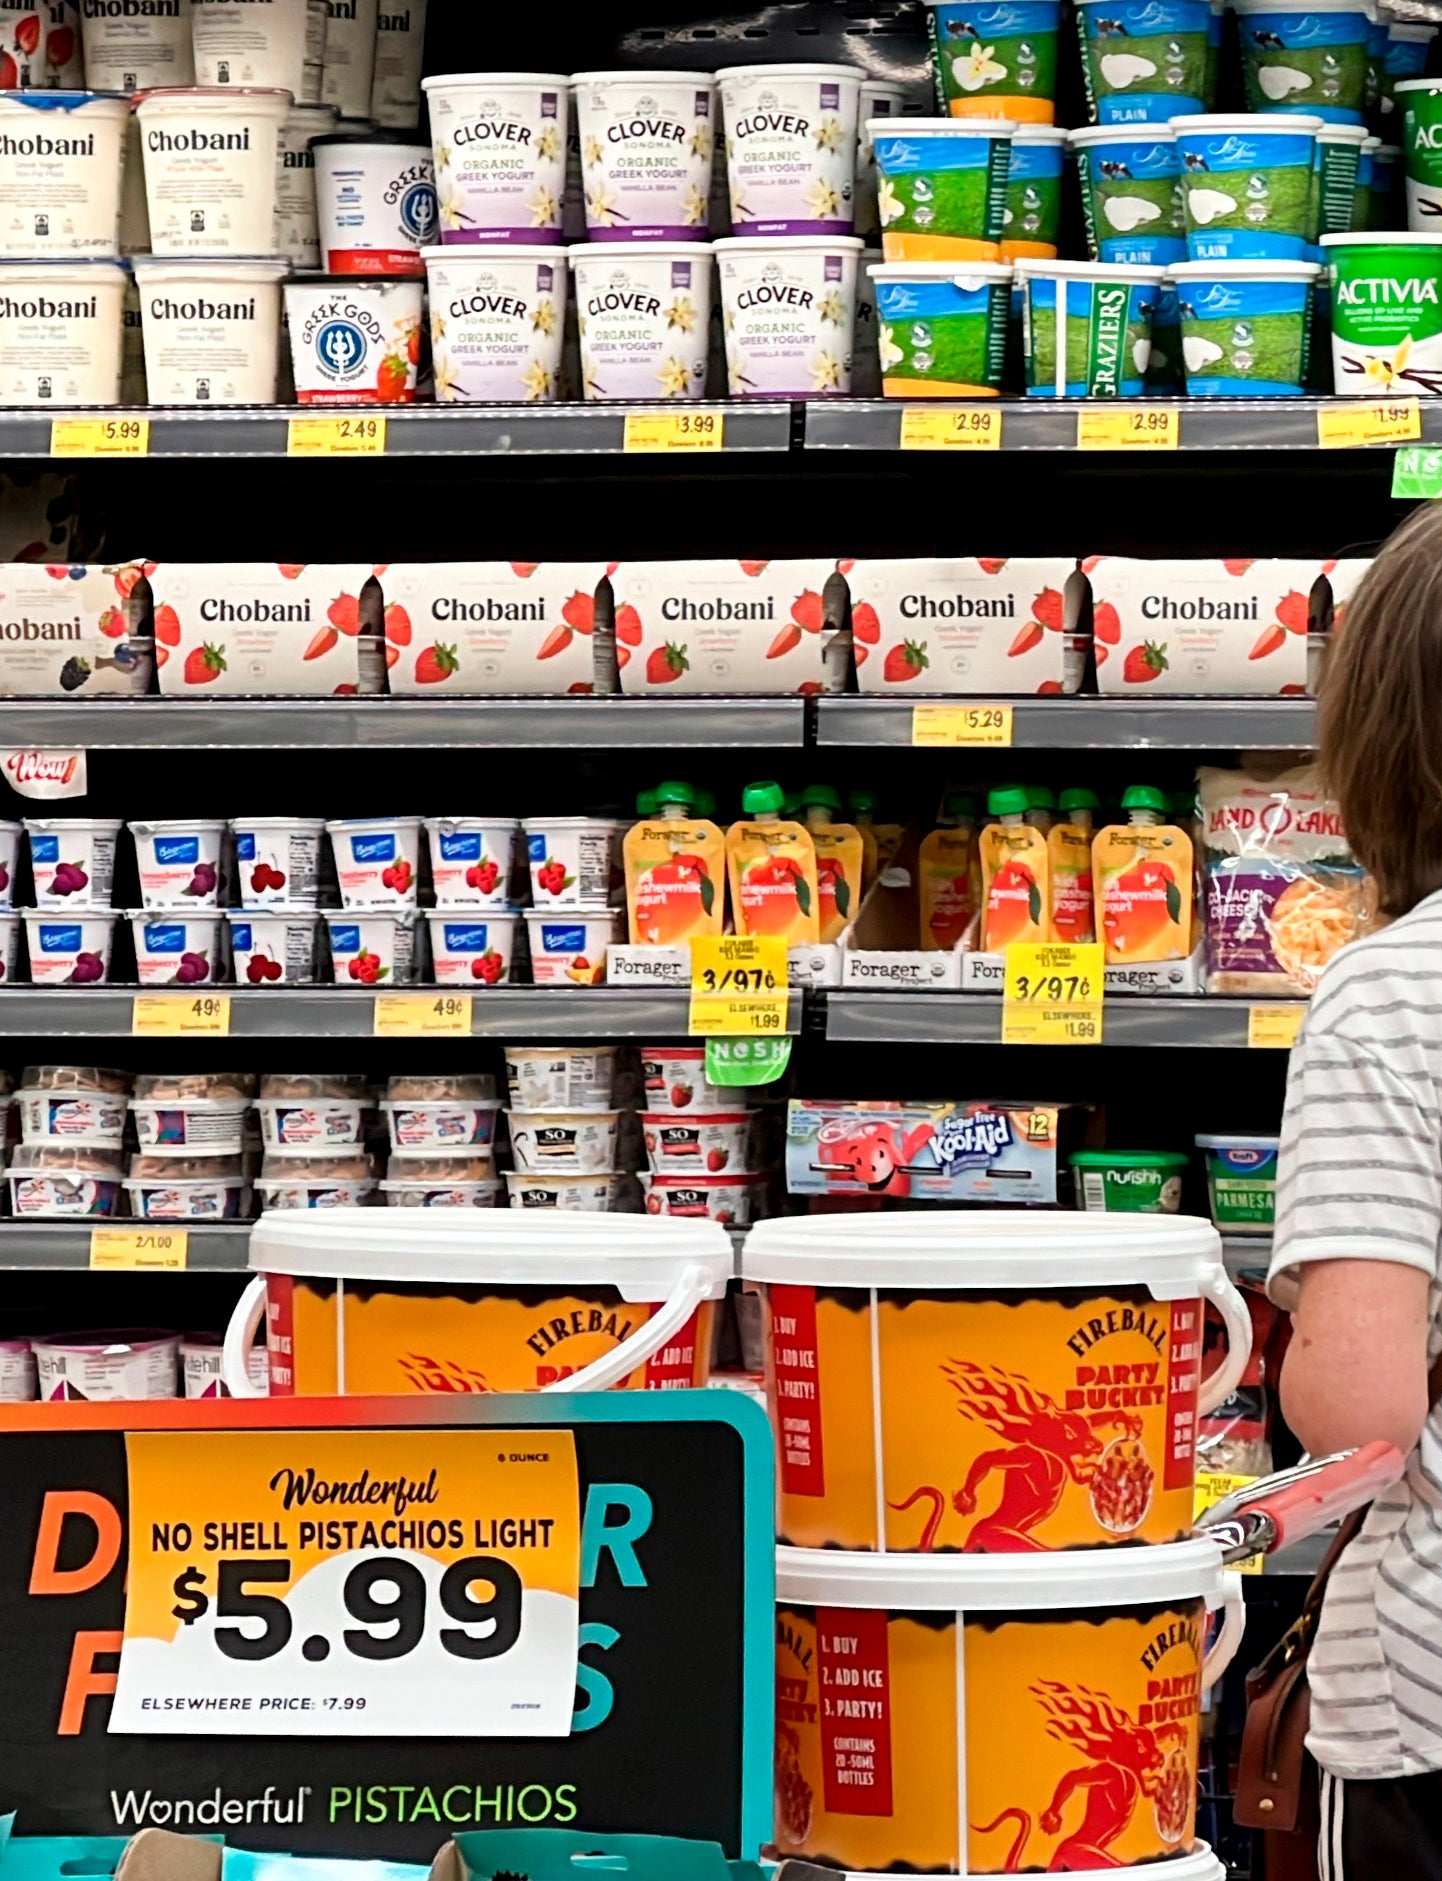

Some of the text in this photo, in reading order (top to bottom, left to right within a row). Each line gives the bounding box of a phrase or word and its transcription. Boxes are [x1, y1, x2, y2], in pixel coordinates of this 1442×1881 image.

[1111, 108, 1148, 121] PLAIN
[453, 119, 533, 146] CLOVER
[607, 119, 686, 144] CLOVER
[735, 114, 810, 138] CLOVER
[148, 127, 250, 153] Chobani
[463, 159, 525, 171] ORGANIC
[616, 157, 679, 169] ORGANIC
[743, 151, 802, 163] ORGANIC
[456, 171, 535, 183] GREEK YOGURT
[608, 169, 688, 180] GREEK YOGURT
[768, 163, 813, 173] YOGURT
[1114, 252, 1151, 264] PLAIN
[1196, 245, 1228, 258] PLAIN
[736, 285, 814, 311] CLOVER
[1336, 277, 1440, 305] ACTIVIA
[151, 298, 256, 321] Chobani
[449, 296, 528, 320] CLOVER
[588, 293, 662, 317] CLOVER
[302, 303, 385, 345] GREEK GODS
[744, 322, 806, 335] ORGANIC
[457, 331, 520, 344] ORGANIC
[594, 329, 653, 342] ORGANIC
[738, 334, 817, 347] GREEK YOGURT
[1091, 288, 1127, 398] GRAZIERS
[451, 344, 530, 355] GREEK YOGURT
[618, 341, 664, 352] YOGURT
[200, 598, 312, 622] Chobani
[431, 597, 546, 622] Chobani
[661, 597, 776, 622] Chobani
[900, 594, 1016, 620] Chobani
[1141, 595, 1260, 622] Chobani
[613, 957, 682, 978] Forager
[850, 960, 920, 980] Forager
[715, 1042, 788, 1058] NOSH
[545, 1129, 566, 1140] SO
[669, 1128, 689, 1140] SO
[1028, 1114, 1049, 1135] 12
[928, 1115, 1010, 1166] Kool-Aid
[1106, 1168, 1162, 1186] nurishh
[529, 1191, 548, 1202] SO
[676, 1190, 698, 1202] SO
[1216, 1192, 1275, 1209] PARMESA
[525, 1309, 633, 1358] FIREBAL
[1066, 1308, 1168, 1358] FIREBALL
[1075, 1362, 1160, 1387] PARTY
[1065, 1385, 1166, 1411] BUCKET
[509, 1453, 551, 1463] OUNCE
[270, 1469, 440, 1516] Wonderful
[152, 1518, 555, 1552] NO SHELL PISTACHIOS LIGHT
[171, 1556, 524, 1662] $5.99
[833, 1636, 858, 1655] BUY
[822, 1666, 884, 1688] 2. ADD ICE
[141, 1696, 368, 1713] ELSEWHERE PRICE: $7.99
[824, 1698, 883, 1720] 3. PARTY!
[834, 1736, 876, 1753] CONTAINS
[837, 1769, 875, 1787] BOTTLES
[110, 1784, 579, 1826] Wonderful PISTACHIOS
